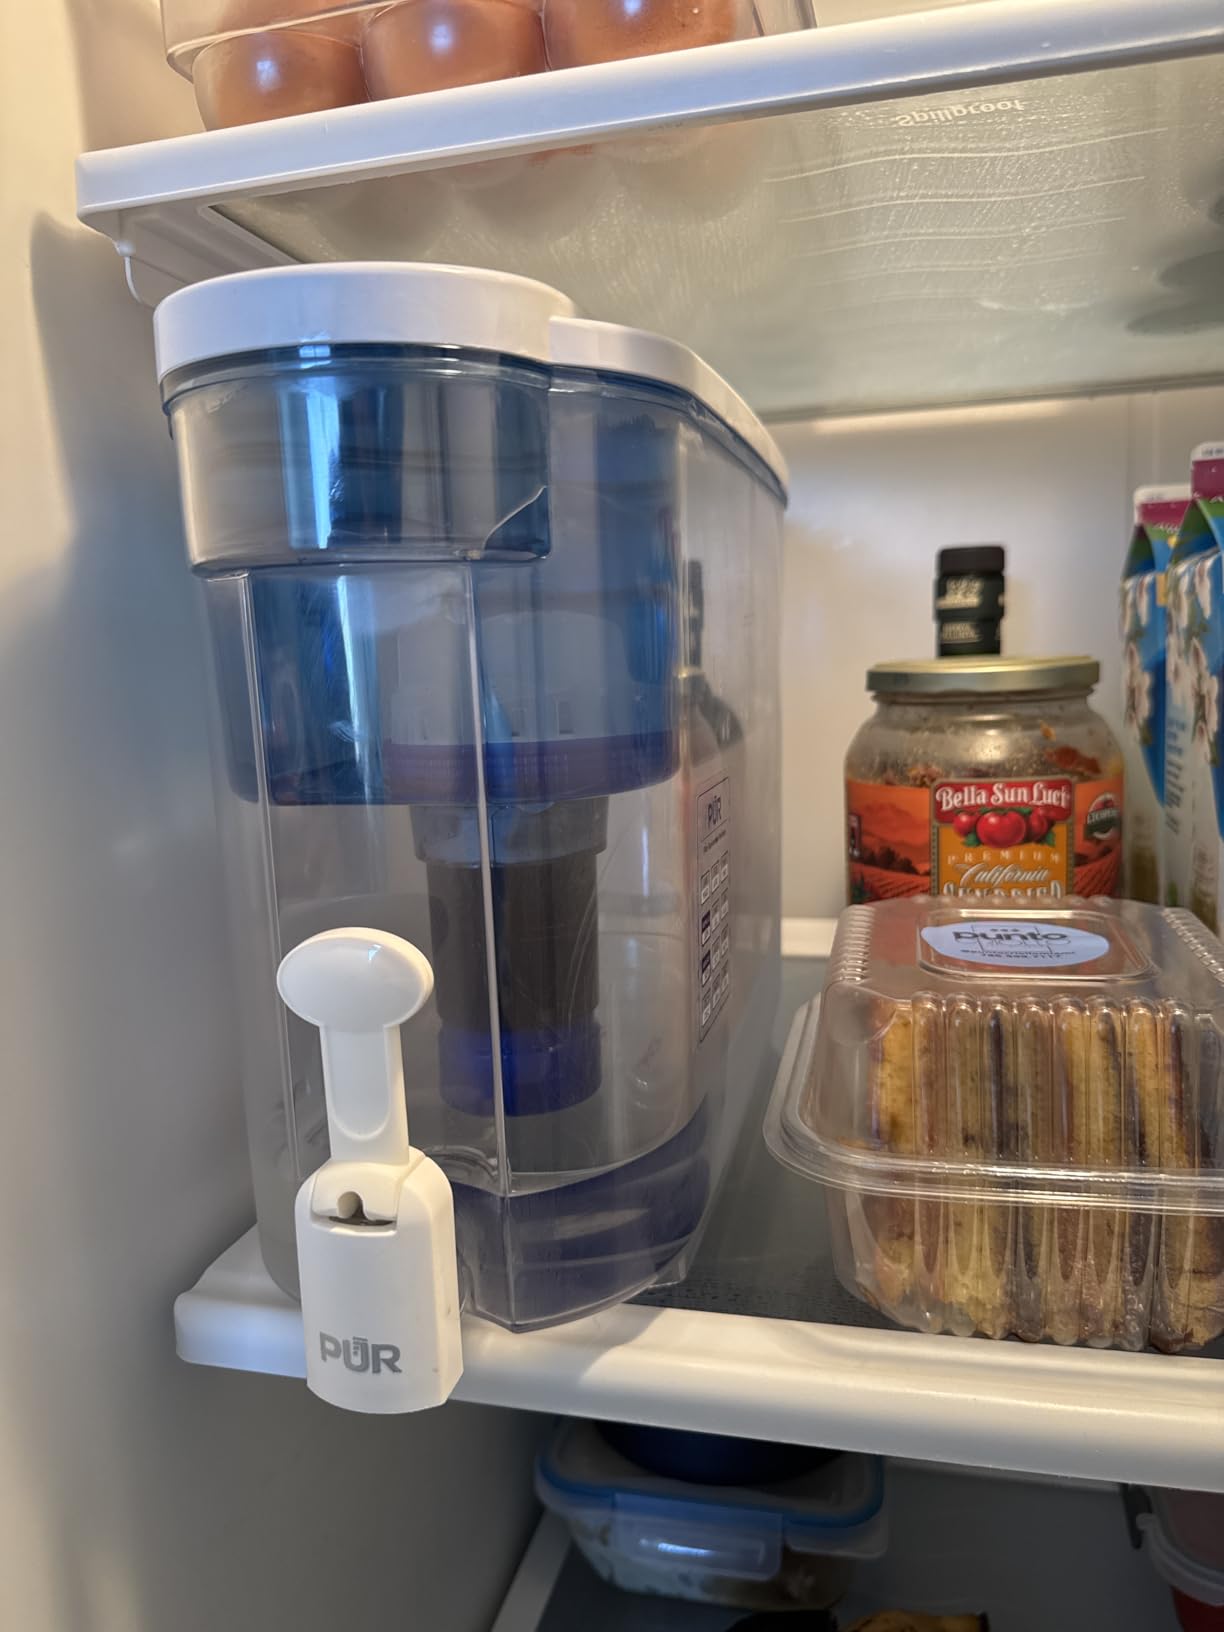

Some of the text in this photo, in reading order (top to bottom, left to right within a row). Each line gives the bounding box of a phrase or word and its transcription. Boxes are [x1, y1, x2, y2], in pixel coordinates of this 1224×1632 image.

[936, 786, 986, 811] Bella
[991, 782, 1029, 805] Sun
[947, 850, 1060, 865] PREMIUM
[955, 862, 1050, 888] California
[952, 931, 1068, 942] punto
